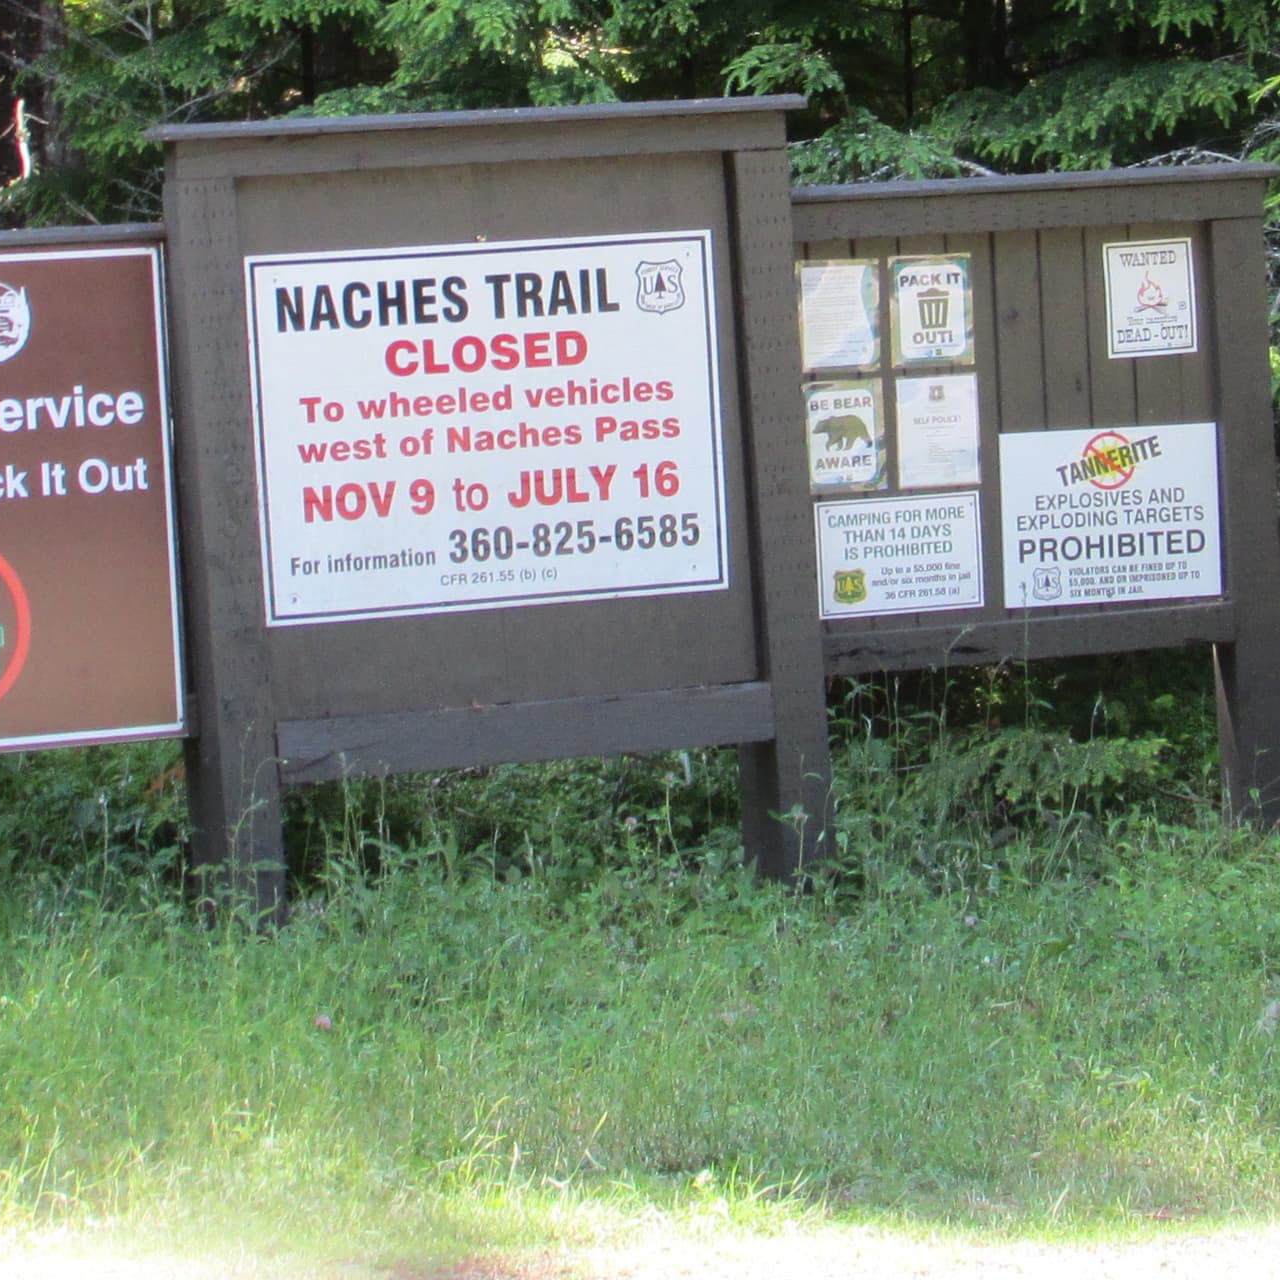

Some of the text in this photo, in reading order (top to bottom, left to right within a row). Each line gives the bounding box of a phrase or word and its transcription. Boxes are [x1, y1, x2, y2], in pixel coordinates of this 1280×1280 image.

[1120, 250, 1177, 267] WANTED
[900, 272, 961, 288] PACK IT
[276, 268, 620, 332] NACHES TRAIL
[912, 330, 954, 345] OUT!
[385, 330, 588, 377] CLOSED
[299, 377, 674, 423] To wheeled vehicles
[810, 396, 873, 412] BE BEAR
[297, 416, 681, 463] west of Naches Pass
[815, 454, 873, 470] AWARE
[1056, 435, 1162, 487] TANNERITE
[41, 462, 66, 496] It
[78, 458, 149, 494] Out
[303, 460, 680, 523] NOV 9 to JULY 16
[1035, 487, 1185, 511] EXPLOSIVES AND
[827, 505, 965, 529] CAMPING FOR MORE
[1017, 504, 1205, 531] EXPLODING TARGETS
[290, 513, 700, 576] For information 360-825-6585
[843, 523, 952, 545] THAN 14 DAYS
[844, 540, 953, 561] IS PROHIBITED
[1019, 528, 1206, 564] PROHIBITED
[440, 567, 558, 586] CFR 261.55 (b) (c)
[915, 573, 947, 584] months
[1069, 561, 1187, 577] VIOLATORS CAN BE FINED UP TO
[1129, 572, 1177, 583] IMPRISONED
[1178, 570, 1188, 580] UP
[1191, 570, 1201, 579] TO
[898, 589, 916, 598] CFR
[1070, 588, 1081, 598] SIX
[1084, 586, 1115, 597] MONTHS
[1117, 585, 1125, 595] IN
